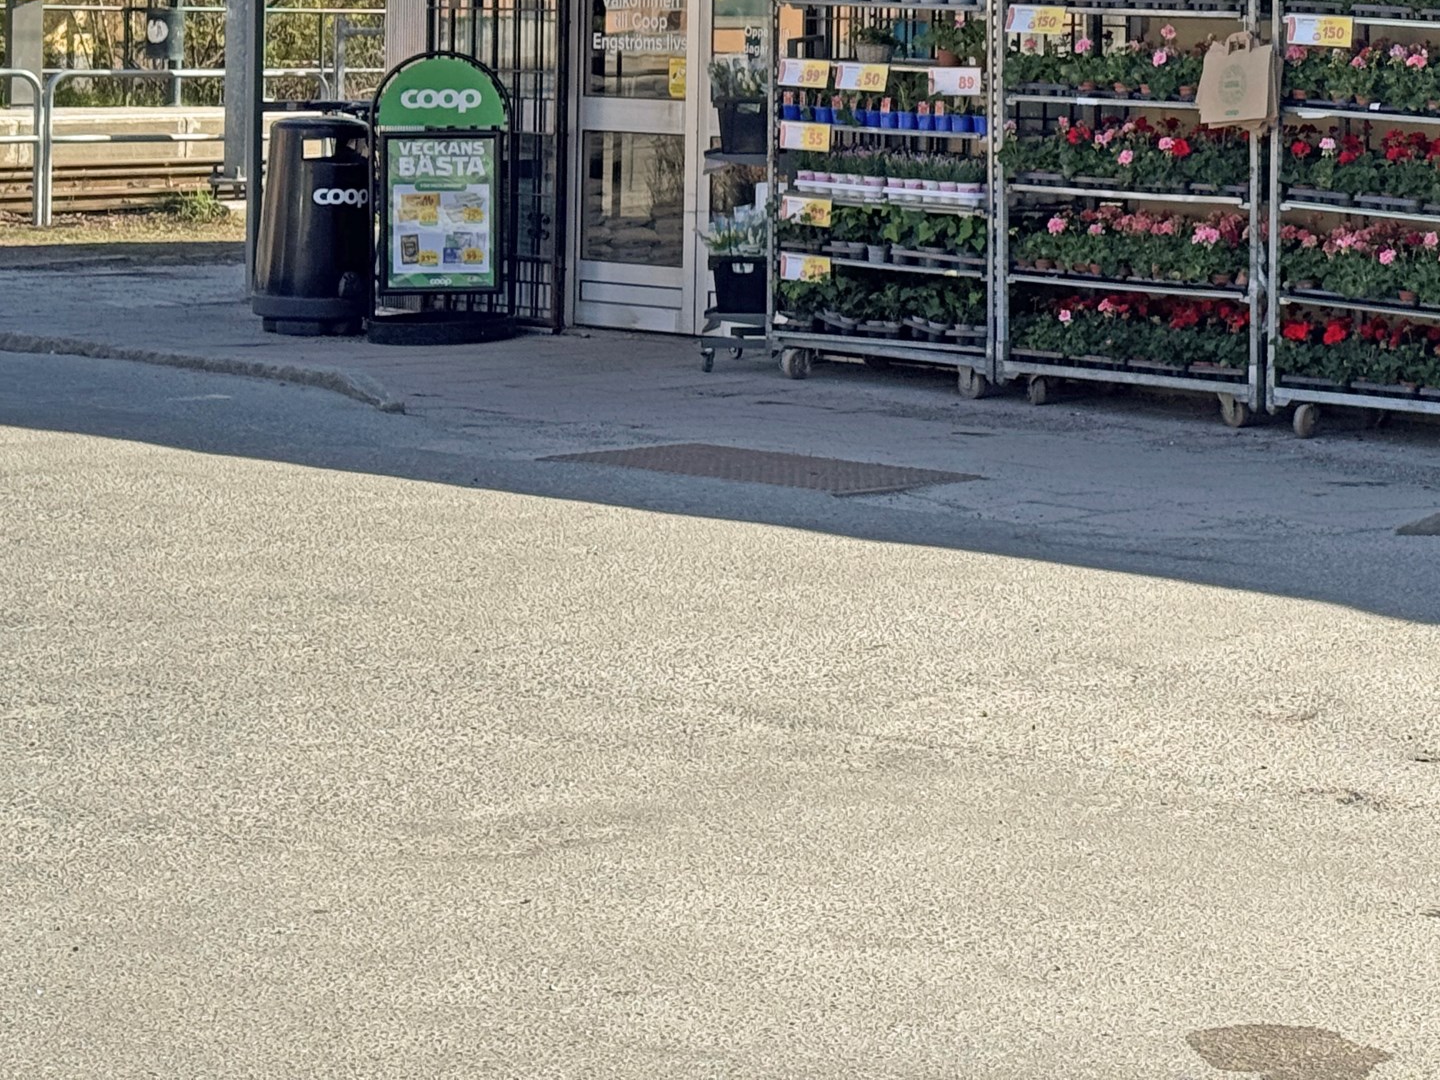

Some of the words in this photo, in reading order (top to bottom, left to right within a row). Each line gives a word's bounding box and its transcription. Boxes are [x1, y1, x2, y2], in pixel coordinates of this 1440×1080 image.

[632, 12, 668, 33] Coop
[592, 32, 663, 55] Engströms
[666, 33, 688, 51] livs
[401, 89, 482, 113] coop
[398, 141, 485, 156] VECKANS
[398, 154, 486, 177] BÄSTA
[313, 188, 369, 209] coop
